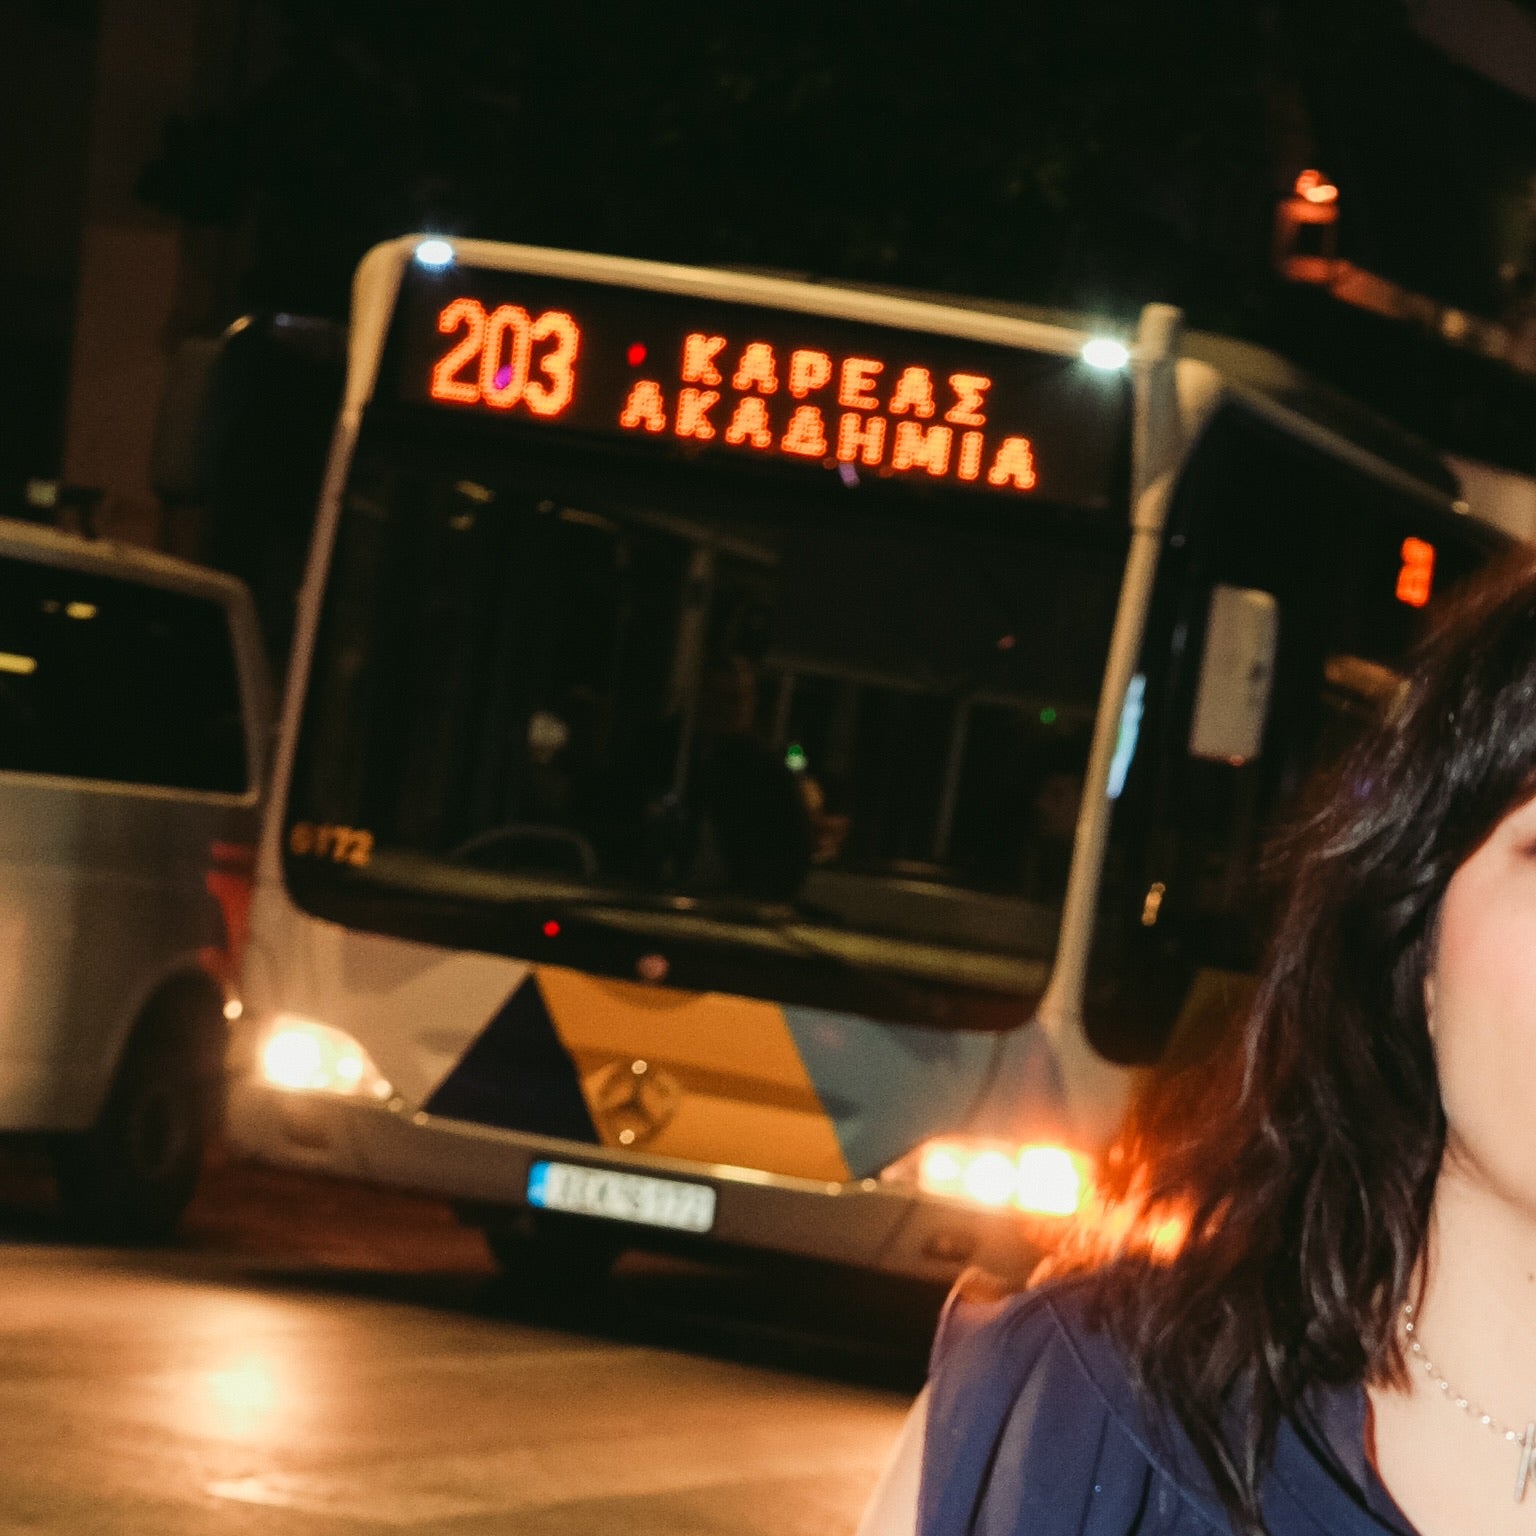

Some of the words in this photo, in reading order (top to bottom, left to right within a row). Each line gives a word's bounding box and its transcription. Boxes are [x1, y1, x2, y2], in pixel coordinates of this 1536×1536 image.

[429, 296, 582, 419] 203
[681, 332, 992, 427] ΚΑΡΕΑΣ
[619, 379, 1037, 491] ΑΚΑΔΗΜΙΑ
